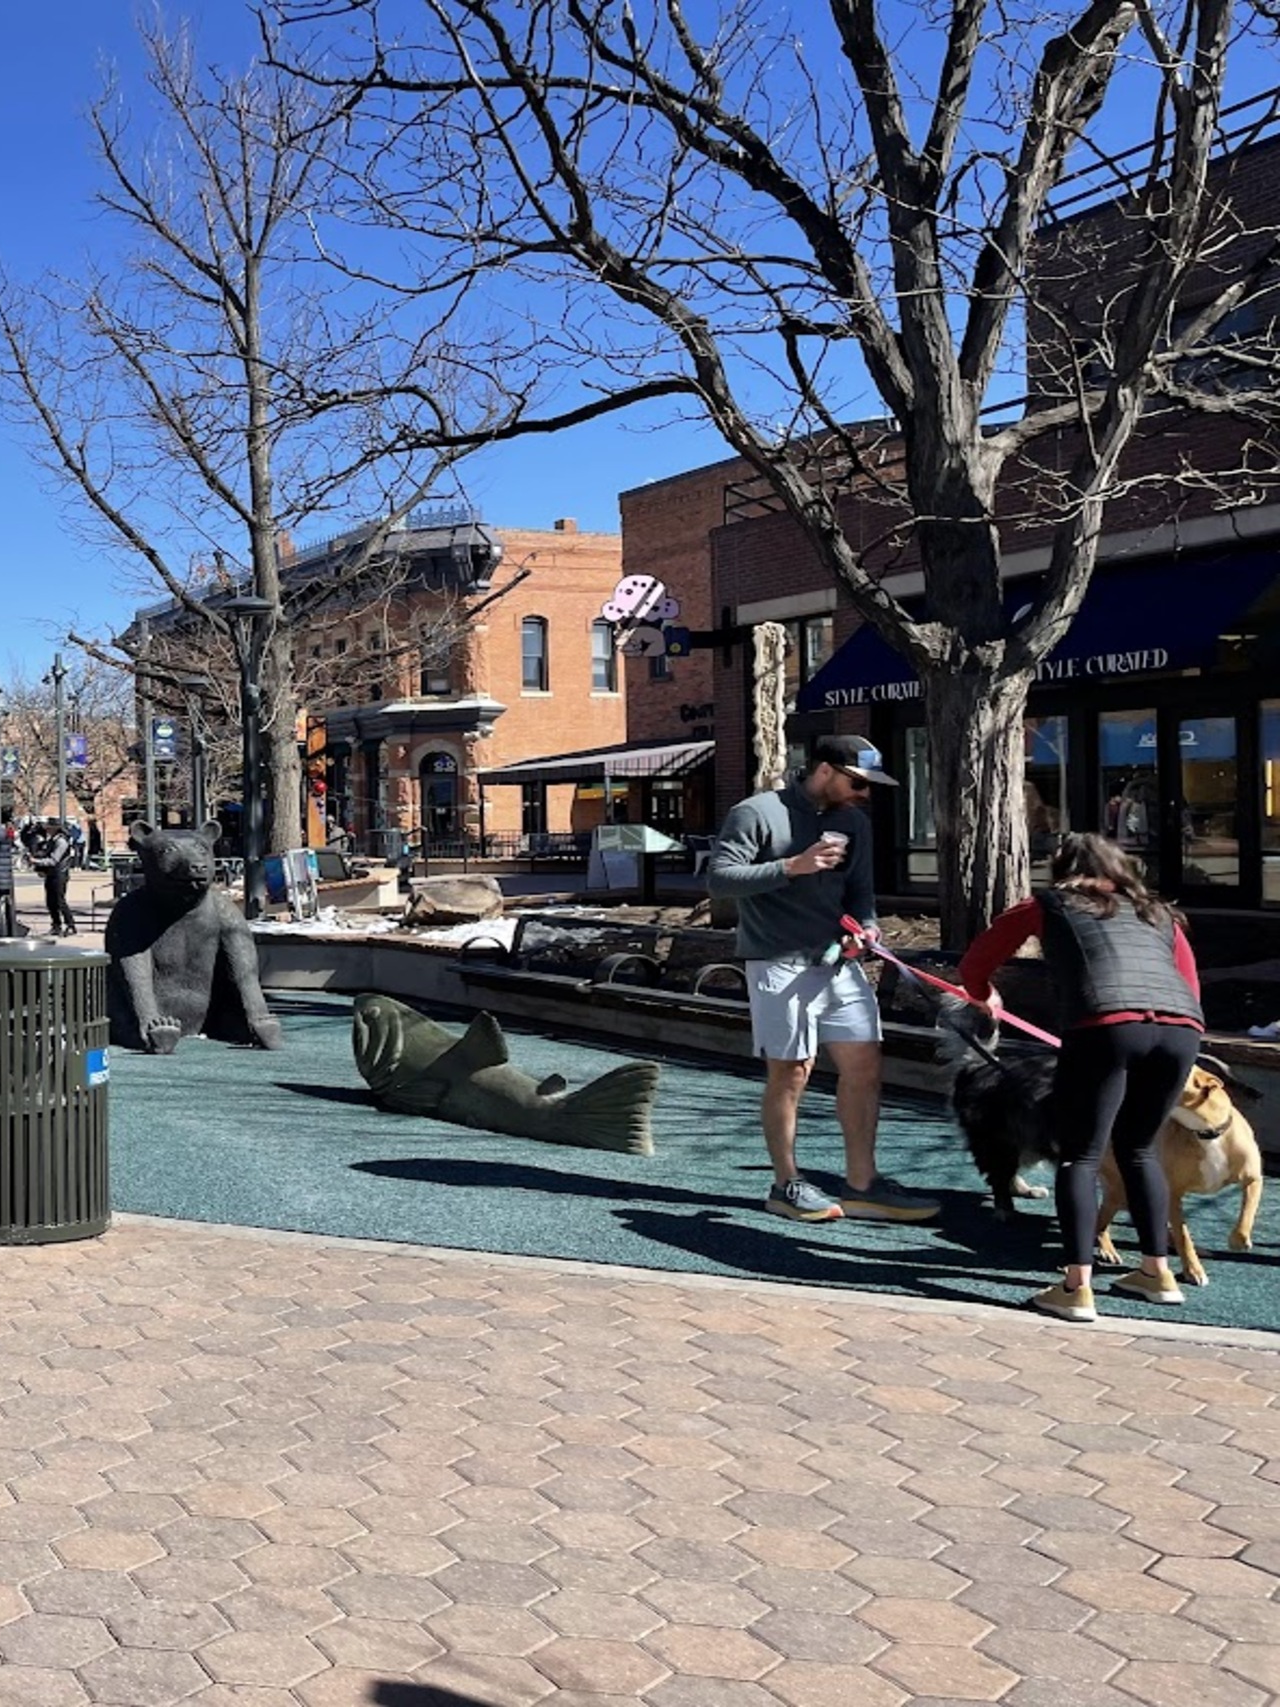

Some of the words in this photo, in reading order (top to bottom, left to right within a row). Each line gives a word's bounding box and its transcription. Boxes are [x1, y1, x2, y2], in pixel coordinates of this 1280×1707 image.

[1036, 657, 1080, 682] TYLE
[1085, 648, 1169, 675] CURATED
[824, 686, 870, 707] STYLE
[870, 680, 924, 701] CURATE
